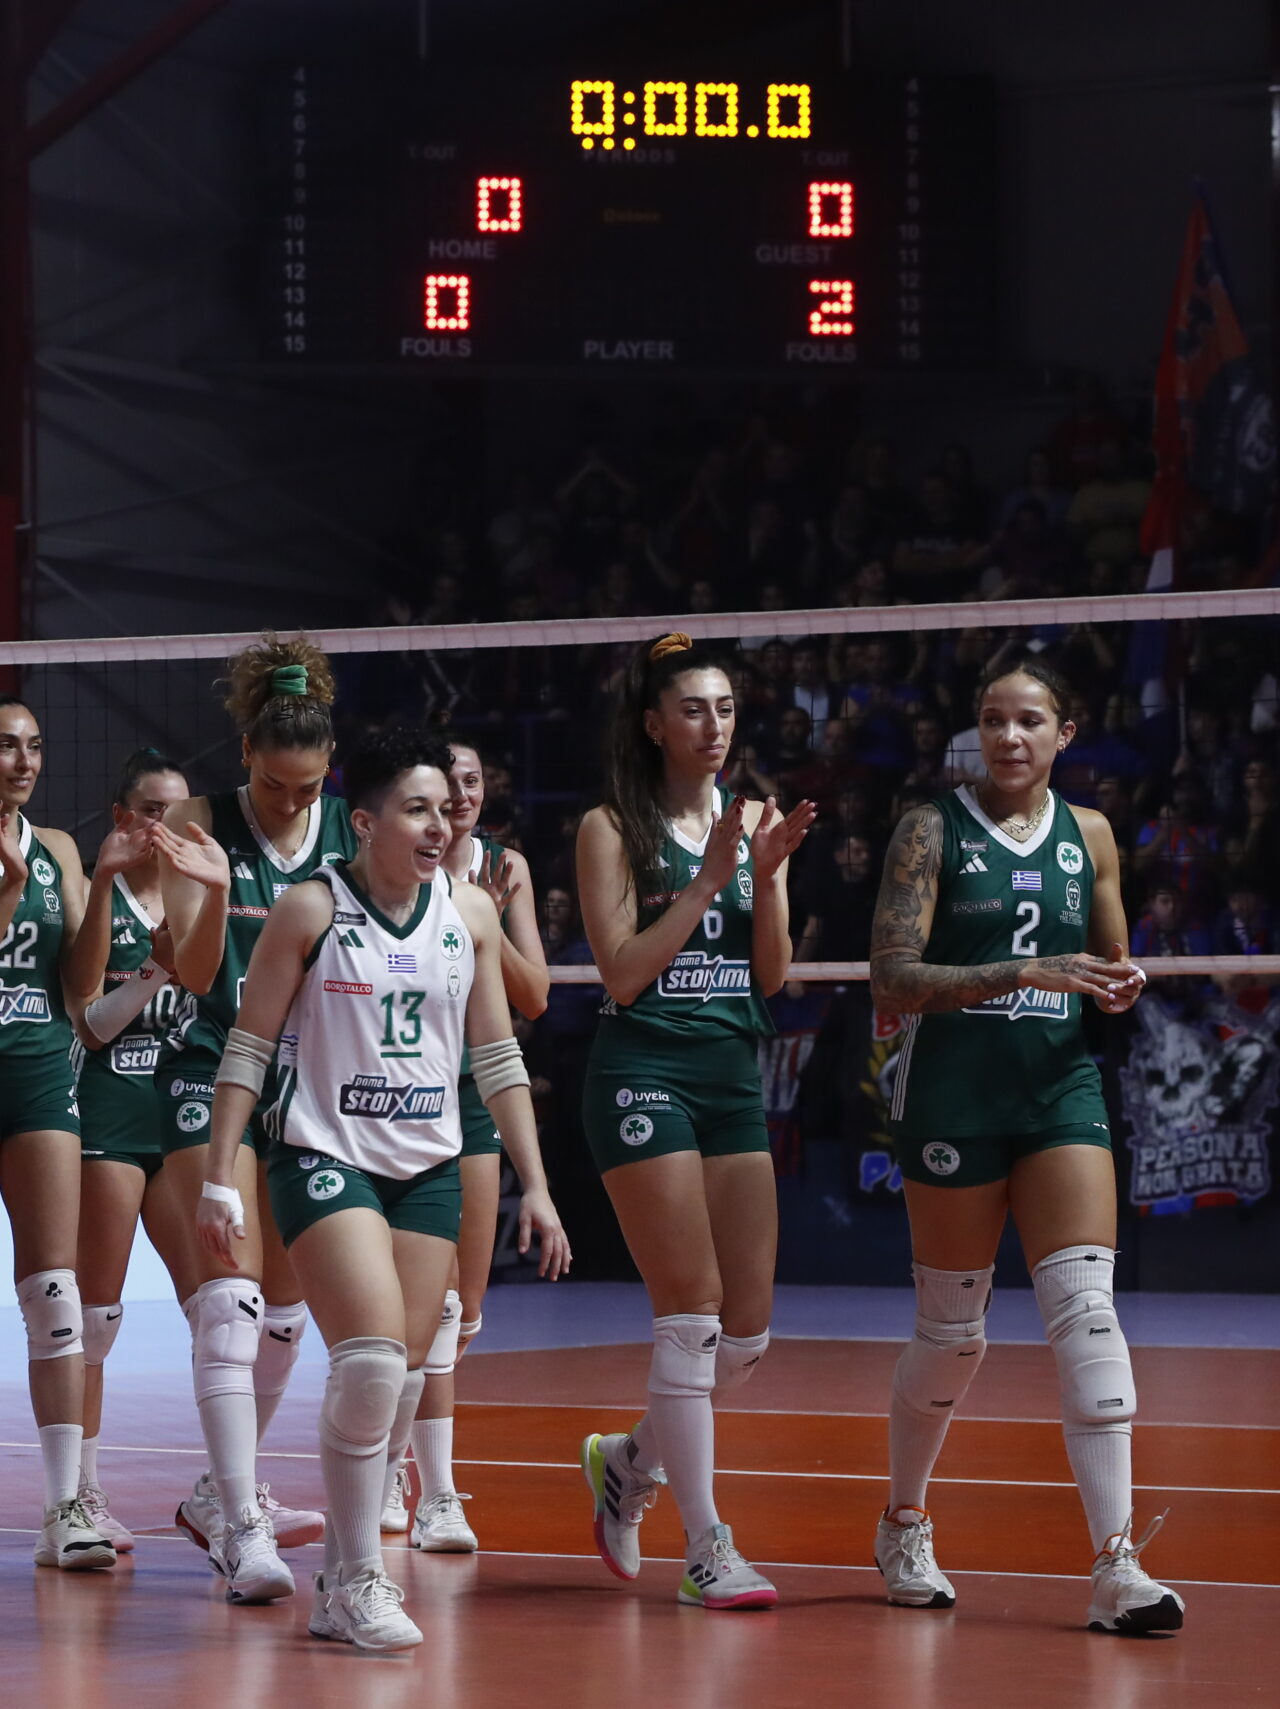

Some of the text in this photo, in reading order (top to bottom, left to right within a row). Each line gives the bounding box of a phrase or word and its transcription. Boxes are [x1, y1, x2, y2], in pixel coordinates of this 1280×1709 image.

[294, 66, 306, 83] 4
[294, 89, 306, 107] 5
[294, 114, 306, 132] 6
[294, 139, 306, 156] 7
[294, 187, 306, 204] 9
[478, 177, 521, 232] 0
[808, 181, 853, 237] 0
[284, 214, 306, 232] 10
[284, 239, 306, 255] 11
[429, 240, 497, 260] HOME
[755, 244, 833, 264] GUEST
[284, 264, 306, 280] 12
[284, 287, 306, 305] 13
[425, 274, 470, 330] 0
[808, 279, 853, 335] 2
[284, 311, 306, 328] 14
[284, 336, 306, 353] 15
[401, 338, 471, 358] FOULS
[584, 340, 675, 361] PLAYER
[785, 343, 857, 363] FOULS
[227, 905, 269, 917] BOROTALCO
[1012, 901, 1041, 957] 2
[324, 981, 372, 994] BOROTALCO
[141, 984, 176, 1030] 10
[380, 990, 426, 1047] 13
[125, 1039, 149, 1049] pame
[354, 1076, 384, 1089] pame
[1138, 1132, 1263, 1171] PERSONA
[1136, 1157, 1266, 1195] NON GRATA
